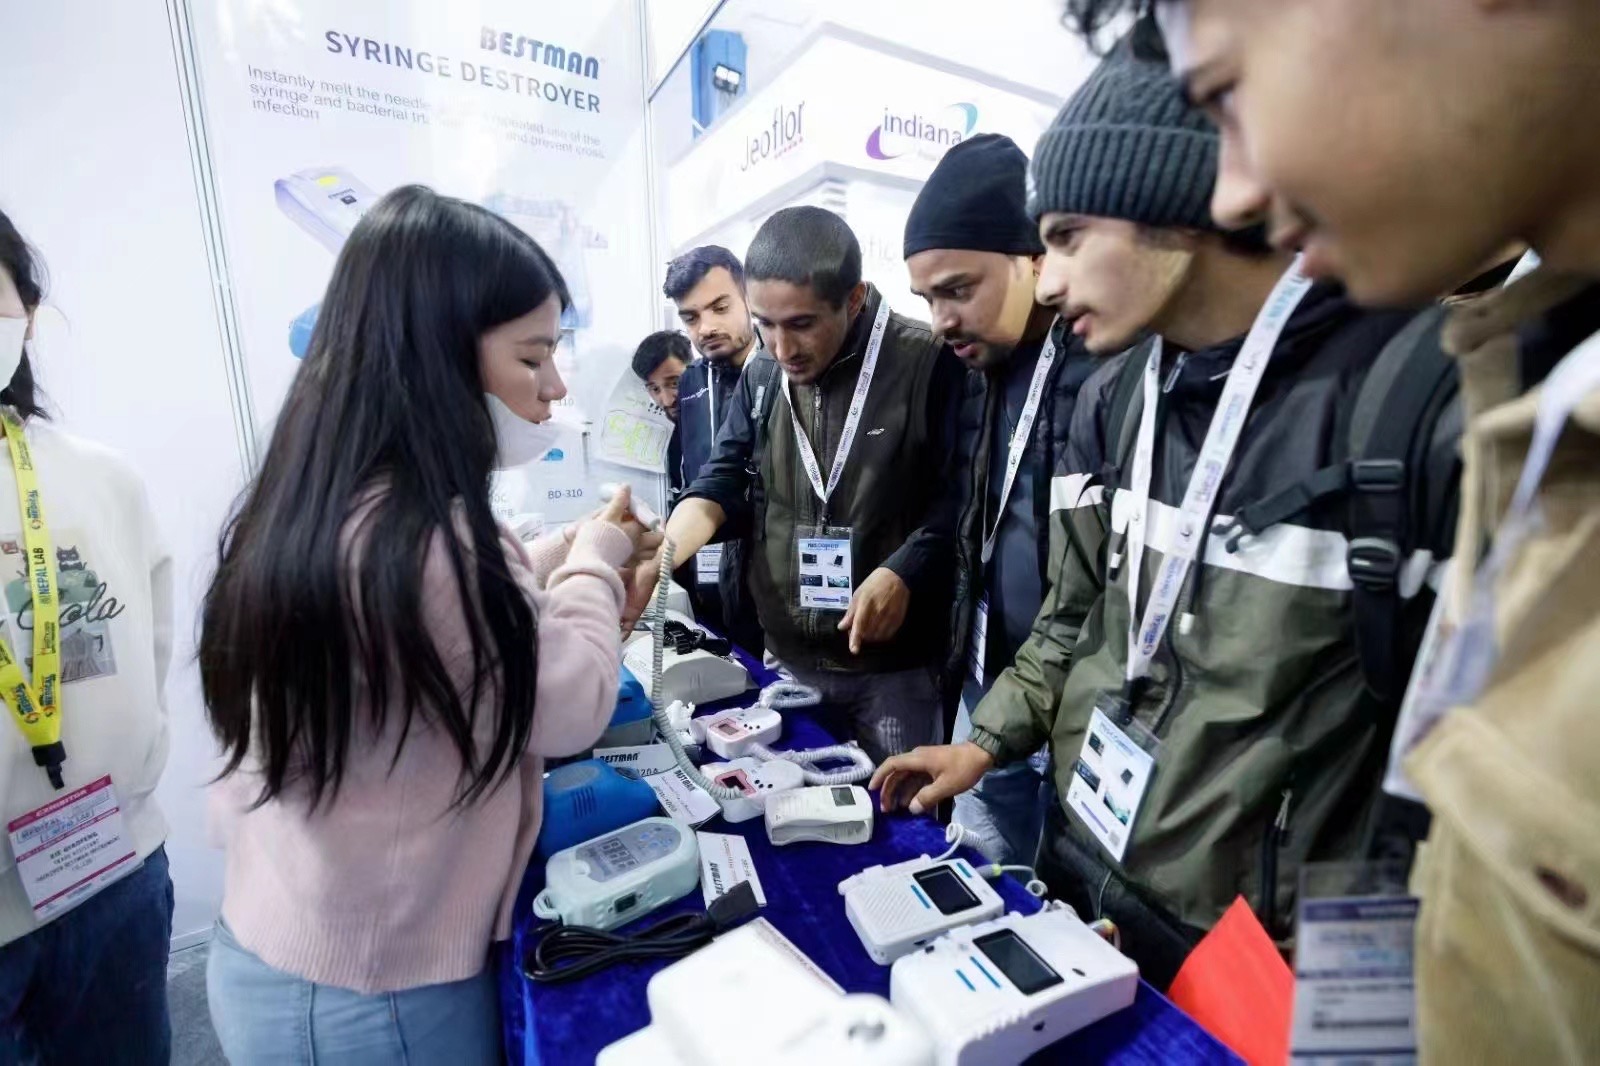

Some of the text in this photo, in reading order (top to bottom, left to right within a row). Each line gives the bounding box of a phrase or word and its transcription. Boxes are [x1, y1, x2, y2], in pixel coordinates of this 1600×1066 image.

[325, 30, 601, 113] SYRINGE DESTROYER
[480, 26, 600, 80] BESTMAN
[248, 64, 315, 91] Instantly
[320, 80, 353, 97] melt
[357, 86, 380, 101] the
[250, 83, 408, 121] syringe and bacterial
[253, 99, 319, 120] infection
[883, 107, 962, 146] indiana
[547, 488, 583, 501] BD-310
[33, 546, 50, 596] NEPAL LAB
